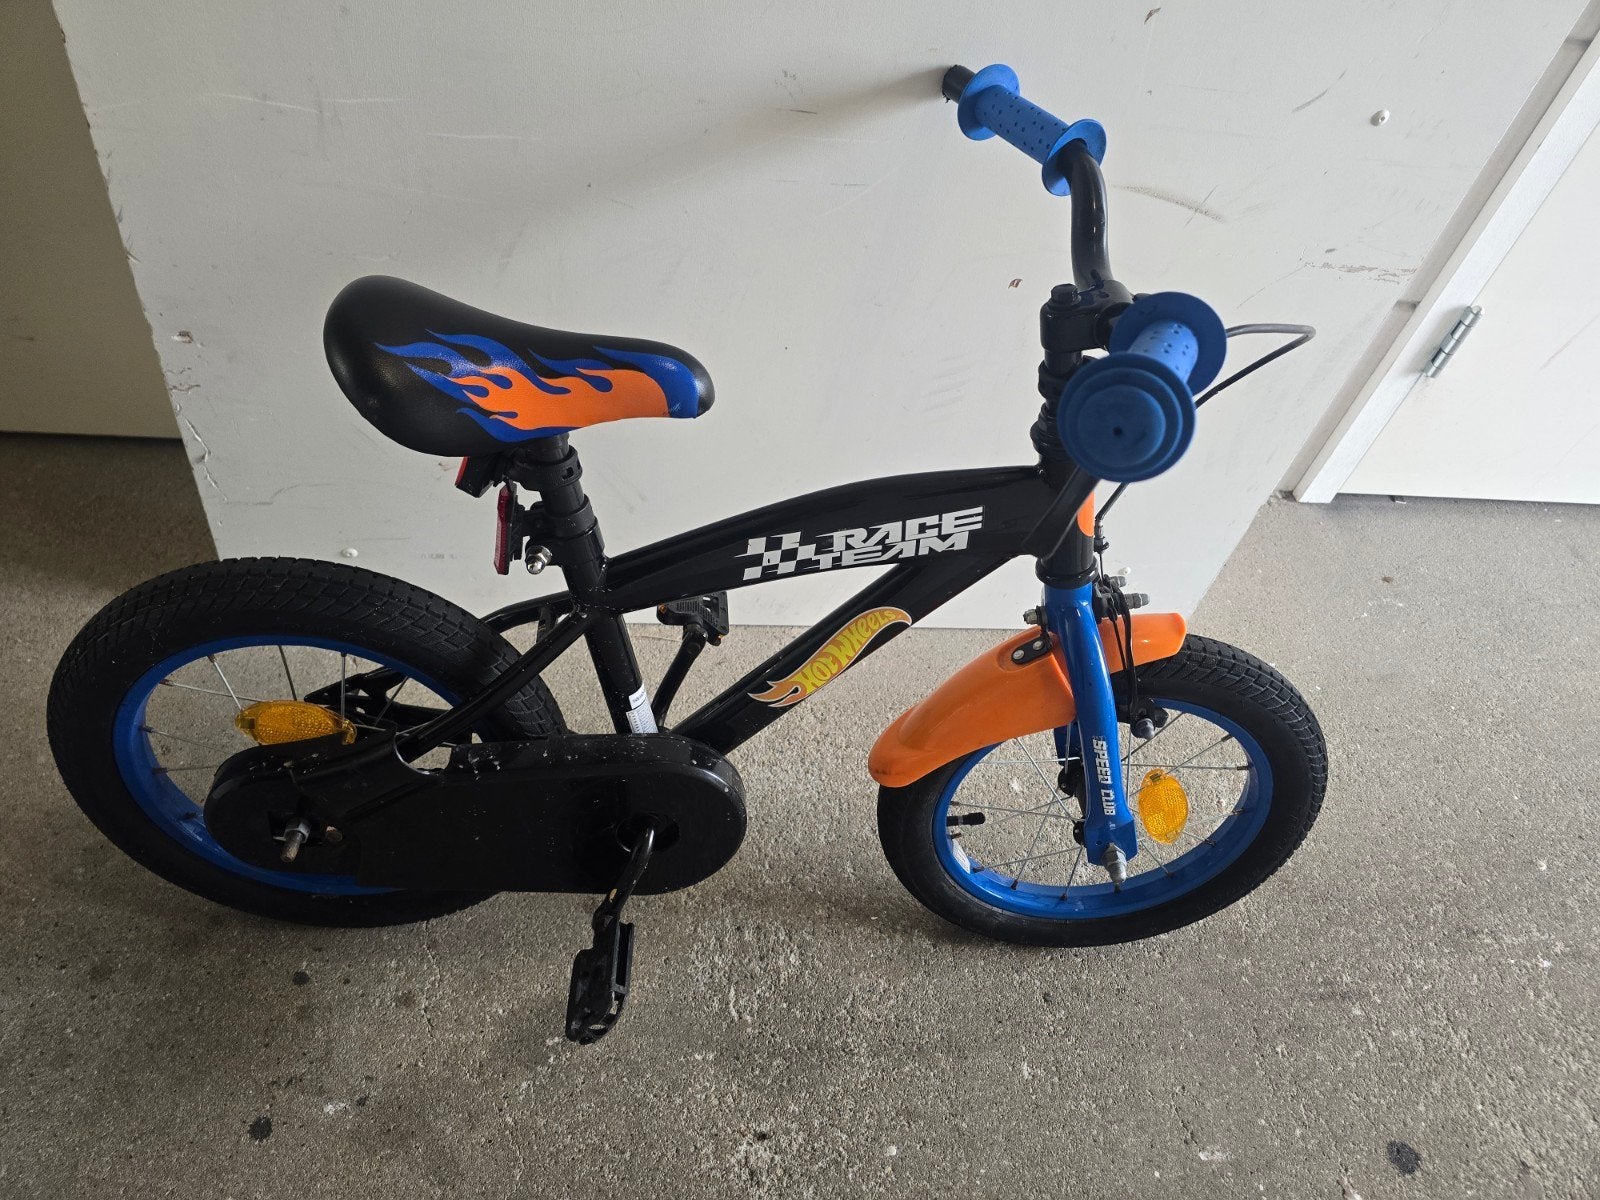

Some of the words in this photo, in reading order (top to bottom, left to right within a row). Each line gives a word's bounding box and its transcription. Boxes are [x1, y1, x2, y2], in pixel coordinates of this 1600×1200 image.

[810, 530, 970, 570] TEAM
[816, 506, 984, 553] RACE
[1092, 739, 1112, 784] SPEED
[1101, 789, 1116, 816] CLUB
